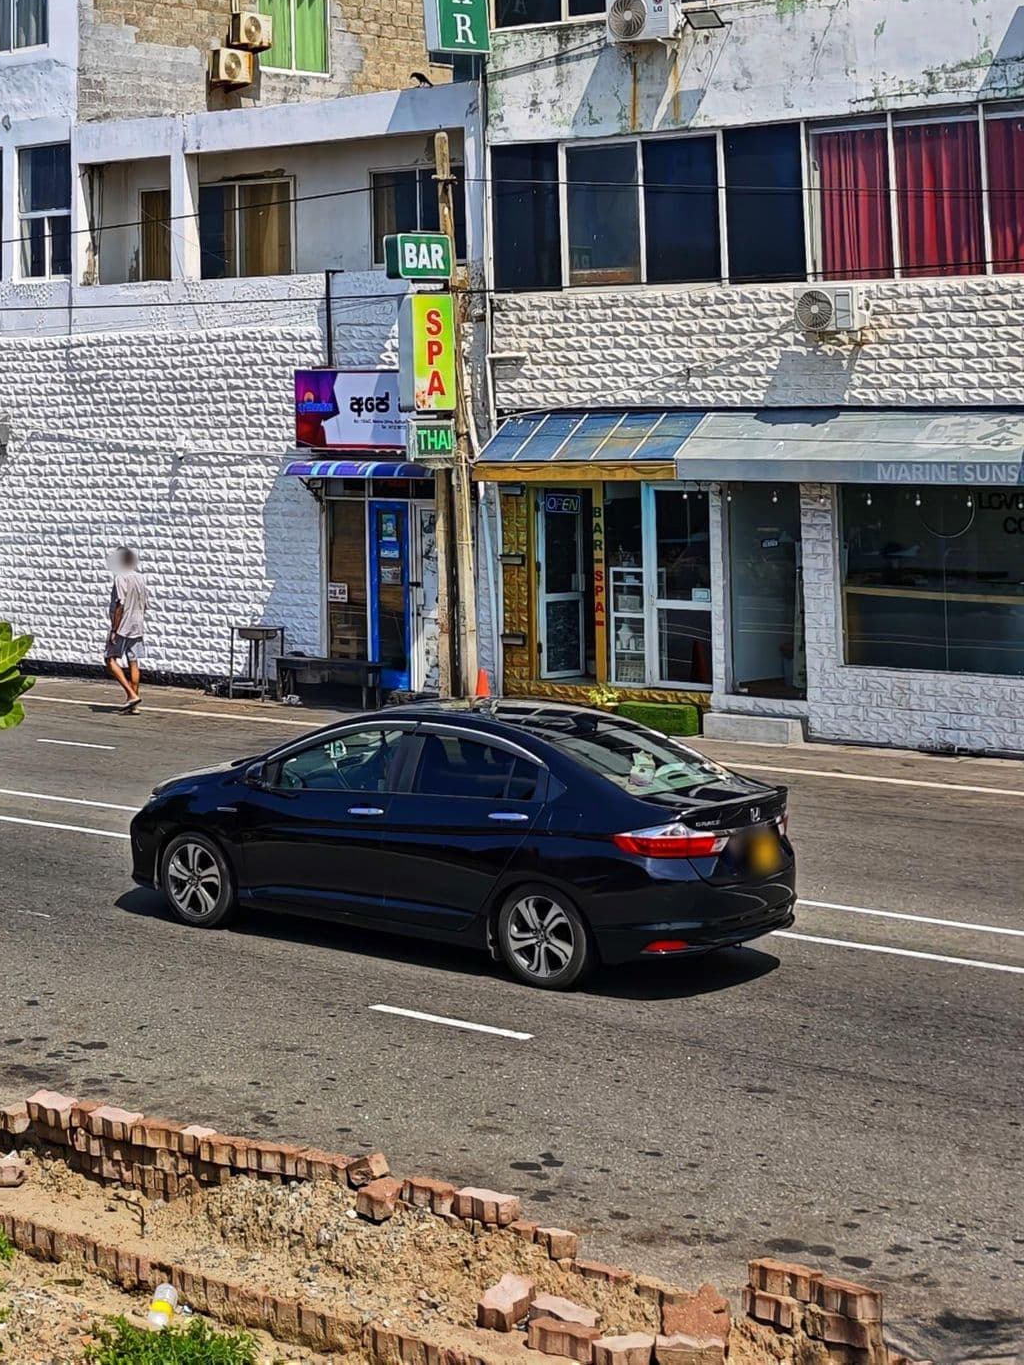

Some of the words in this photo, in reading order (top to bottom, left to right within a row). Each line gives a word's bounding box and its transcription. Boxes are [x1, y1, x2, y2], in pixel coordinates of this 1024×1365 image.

[404, 242, 445, 270] BAR
[425, 309, 446, 396] SPA
[350, 392, 390, 417] අපේ
[418, 430, 452, 451] THAI
[876, 463, 958, 482] MARINE
[964, 464, 1024, 484] SUNS
[547, 496, 578, 512] OPEN
[593, 507, 603, 551] BAR
[594, 570, 605, 613] SPA
